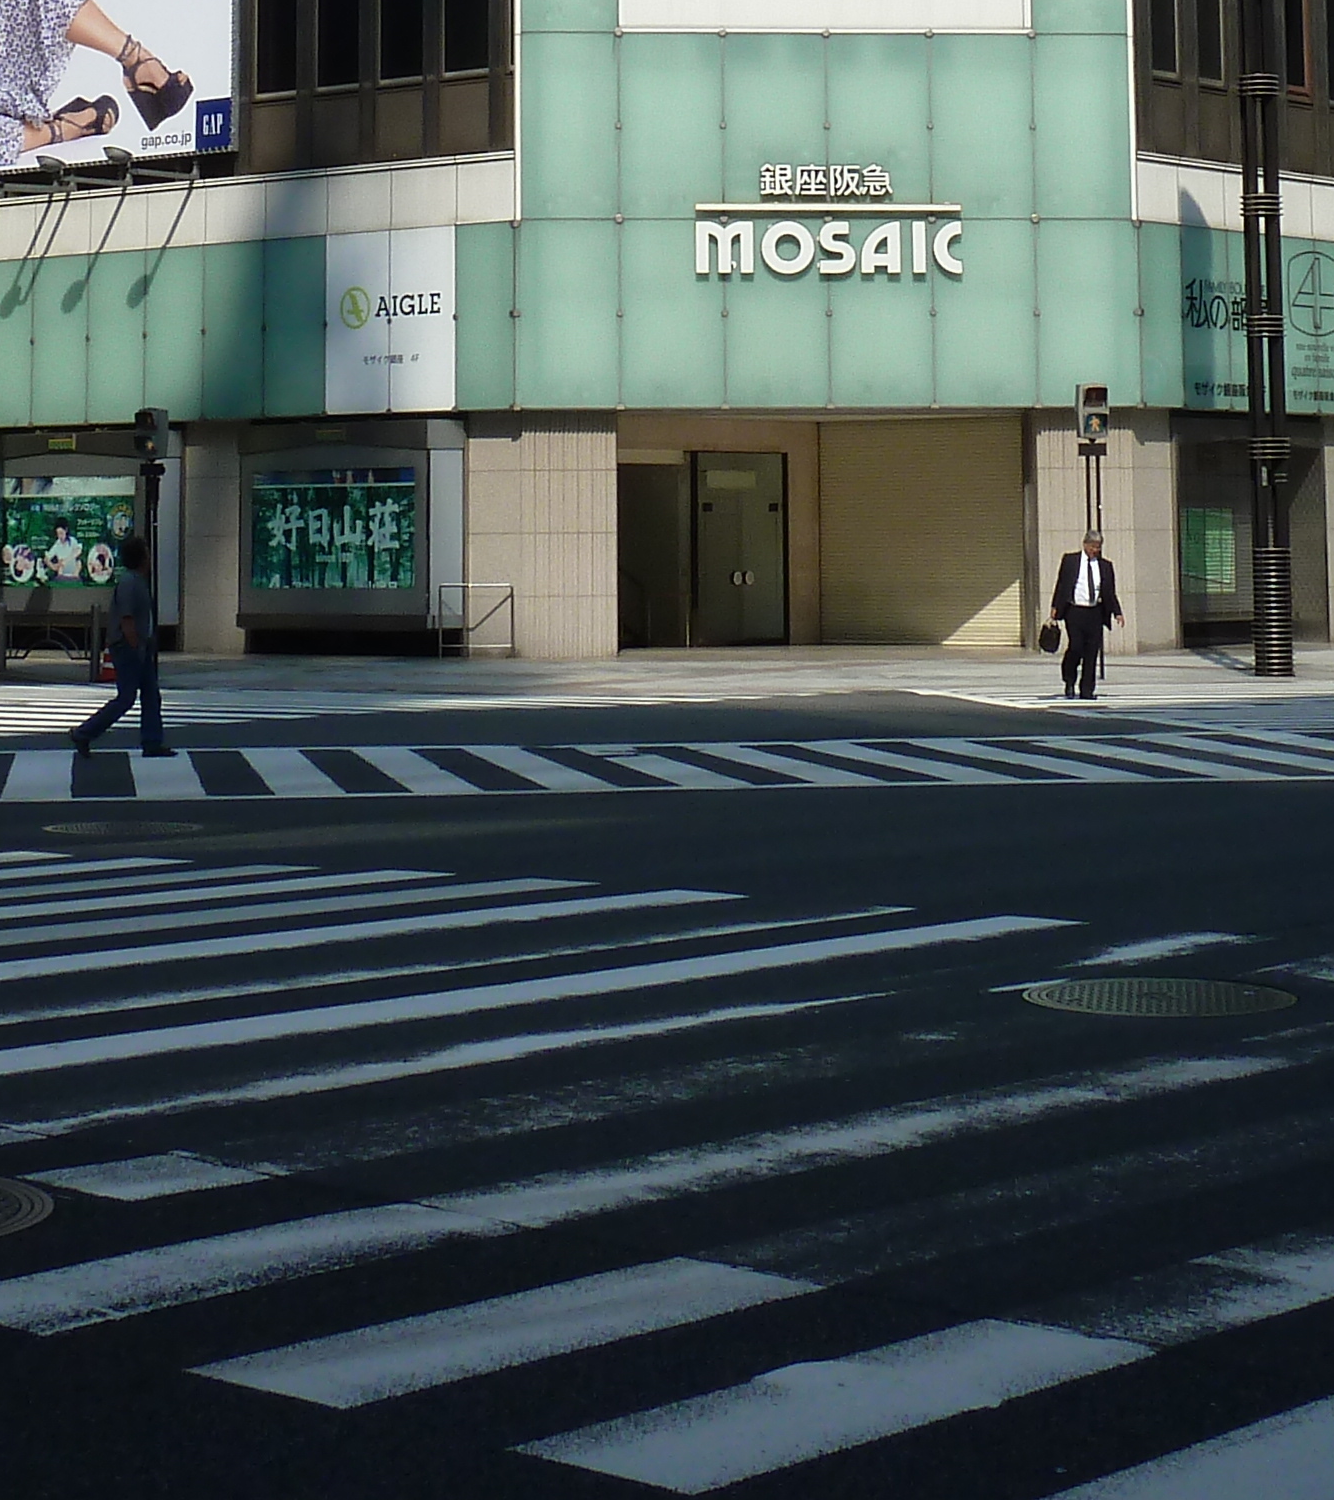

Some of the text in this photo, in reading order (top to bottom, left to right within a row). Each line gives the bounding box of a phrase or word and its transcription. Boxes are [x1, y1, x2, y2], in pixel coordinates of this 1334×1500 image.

[141, 130, 192, 150] gap.co.jp
[203, 113, 224, 135] GAP
[759, 163, 893, 197] 銀座阪急
[695, 219, 964, 275] MOSAIC
[375, 292, 442, 318] AIGLE
[1185, 278, 1268, 331] 私の部
[267, 498, 401, 552] 好日山荘
